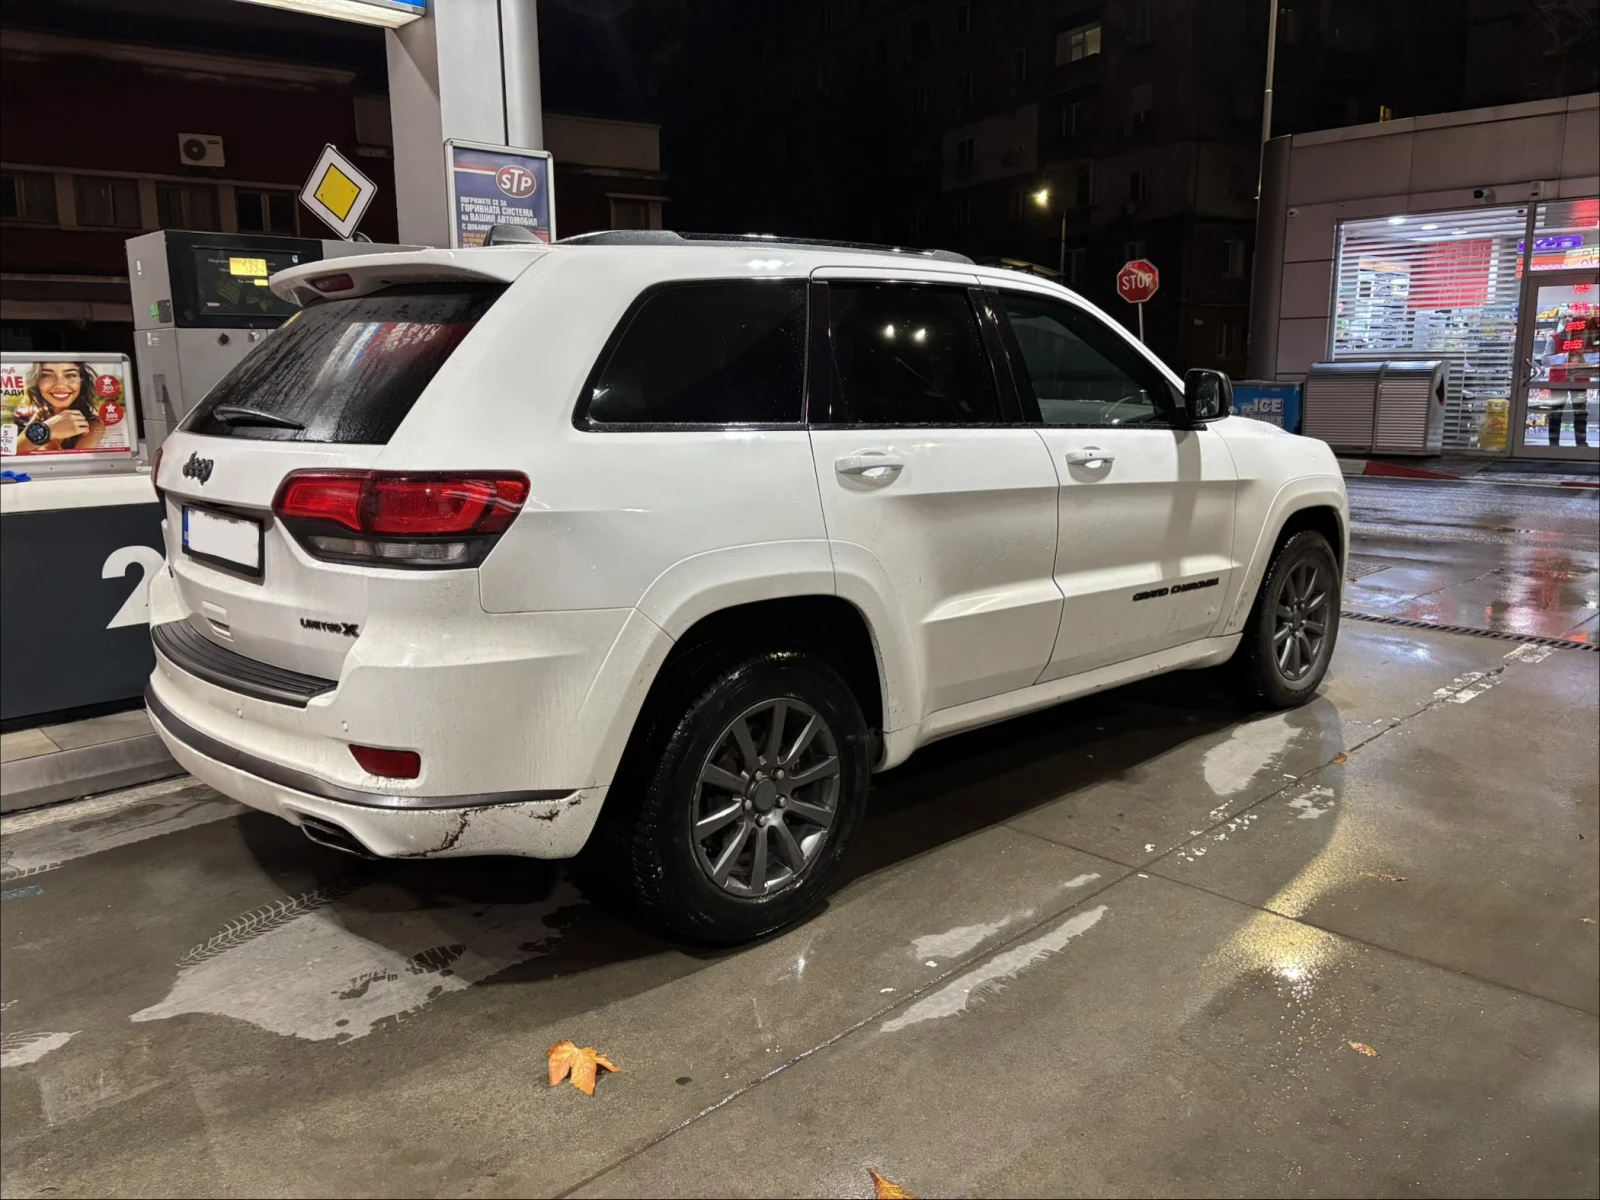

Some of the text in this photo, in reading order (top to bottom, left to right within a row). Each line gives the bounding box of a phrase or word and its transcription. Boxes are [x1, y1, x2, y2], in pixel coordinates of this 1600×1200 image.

[501, 168, 532, 193] STP
[460, 196, 492, 206] ПОГРИЖЕТЕ
[460, 203, 534, 217] ГОРИВНАТА СИСТЕМА
[469, 213, 496, 222] ВАШИЯ
[497, 215, 538, 227] АВТОМОБИЛ
[1122, 272, 1153, 290] STOP
[1253, 398, 1283, 414] ICE
[102, 545, 166, 630] 2
[340, 621, 360, 639] X
